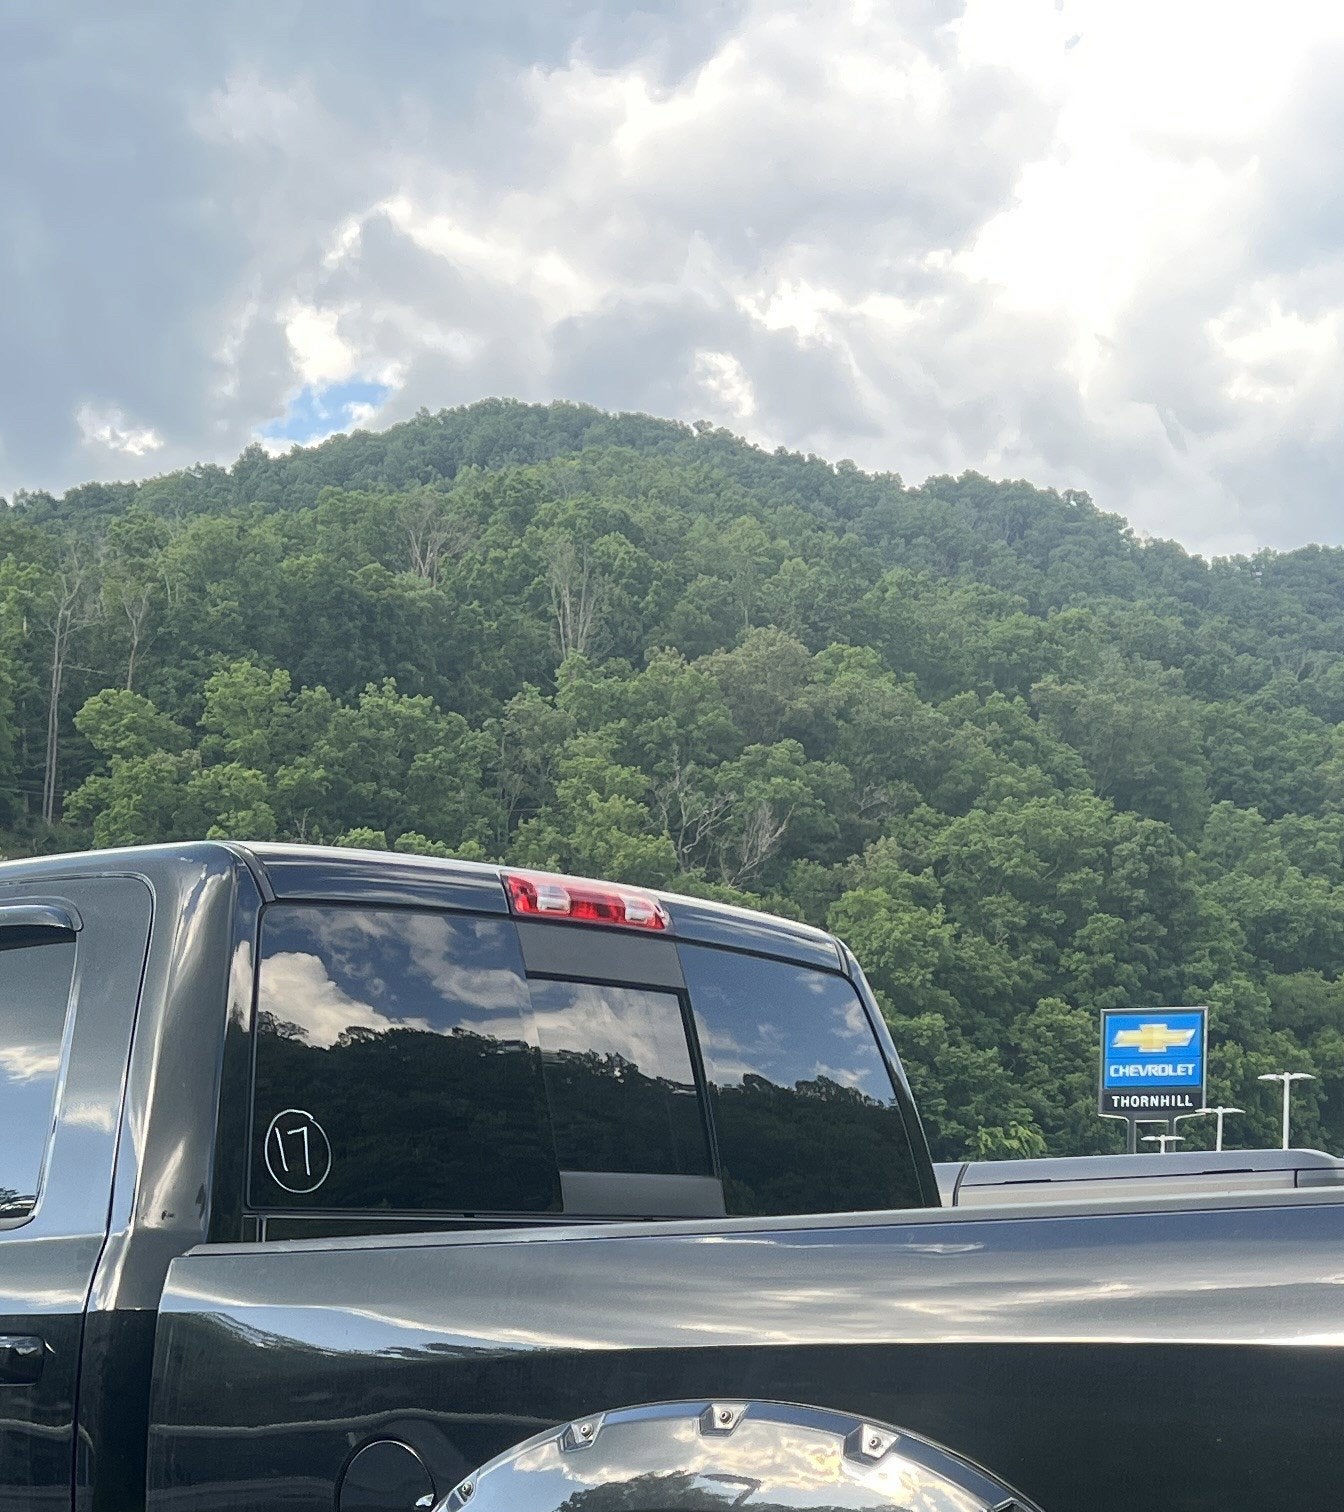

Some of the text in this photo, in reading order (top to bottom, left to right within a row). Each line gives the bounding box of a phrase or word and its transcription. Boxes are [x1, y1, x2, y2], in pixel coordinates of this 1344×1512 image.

[1109, 1063, 1196, 1078] CHEVROLET
[1111, 1094, 1194, 1108] THORNHILL
[274, 1125, 312, 1176] 17
